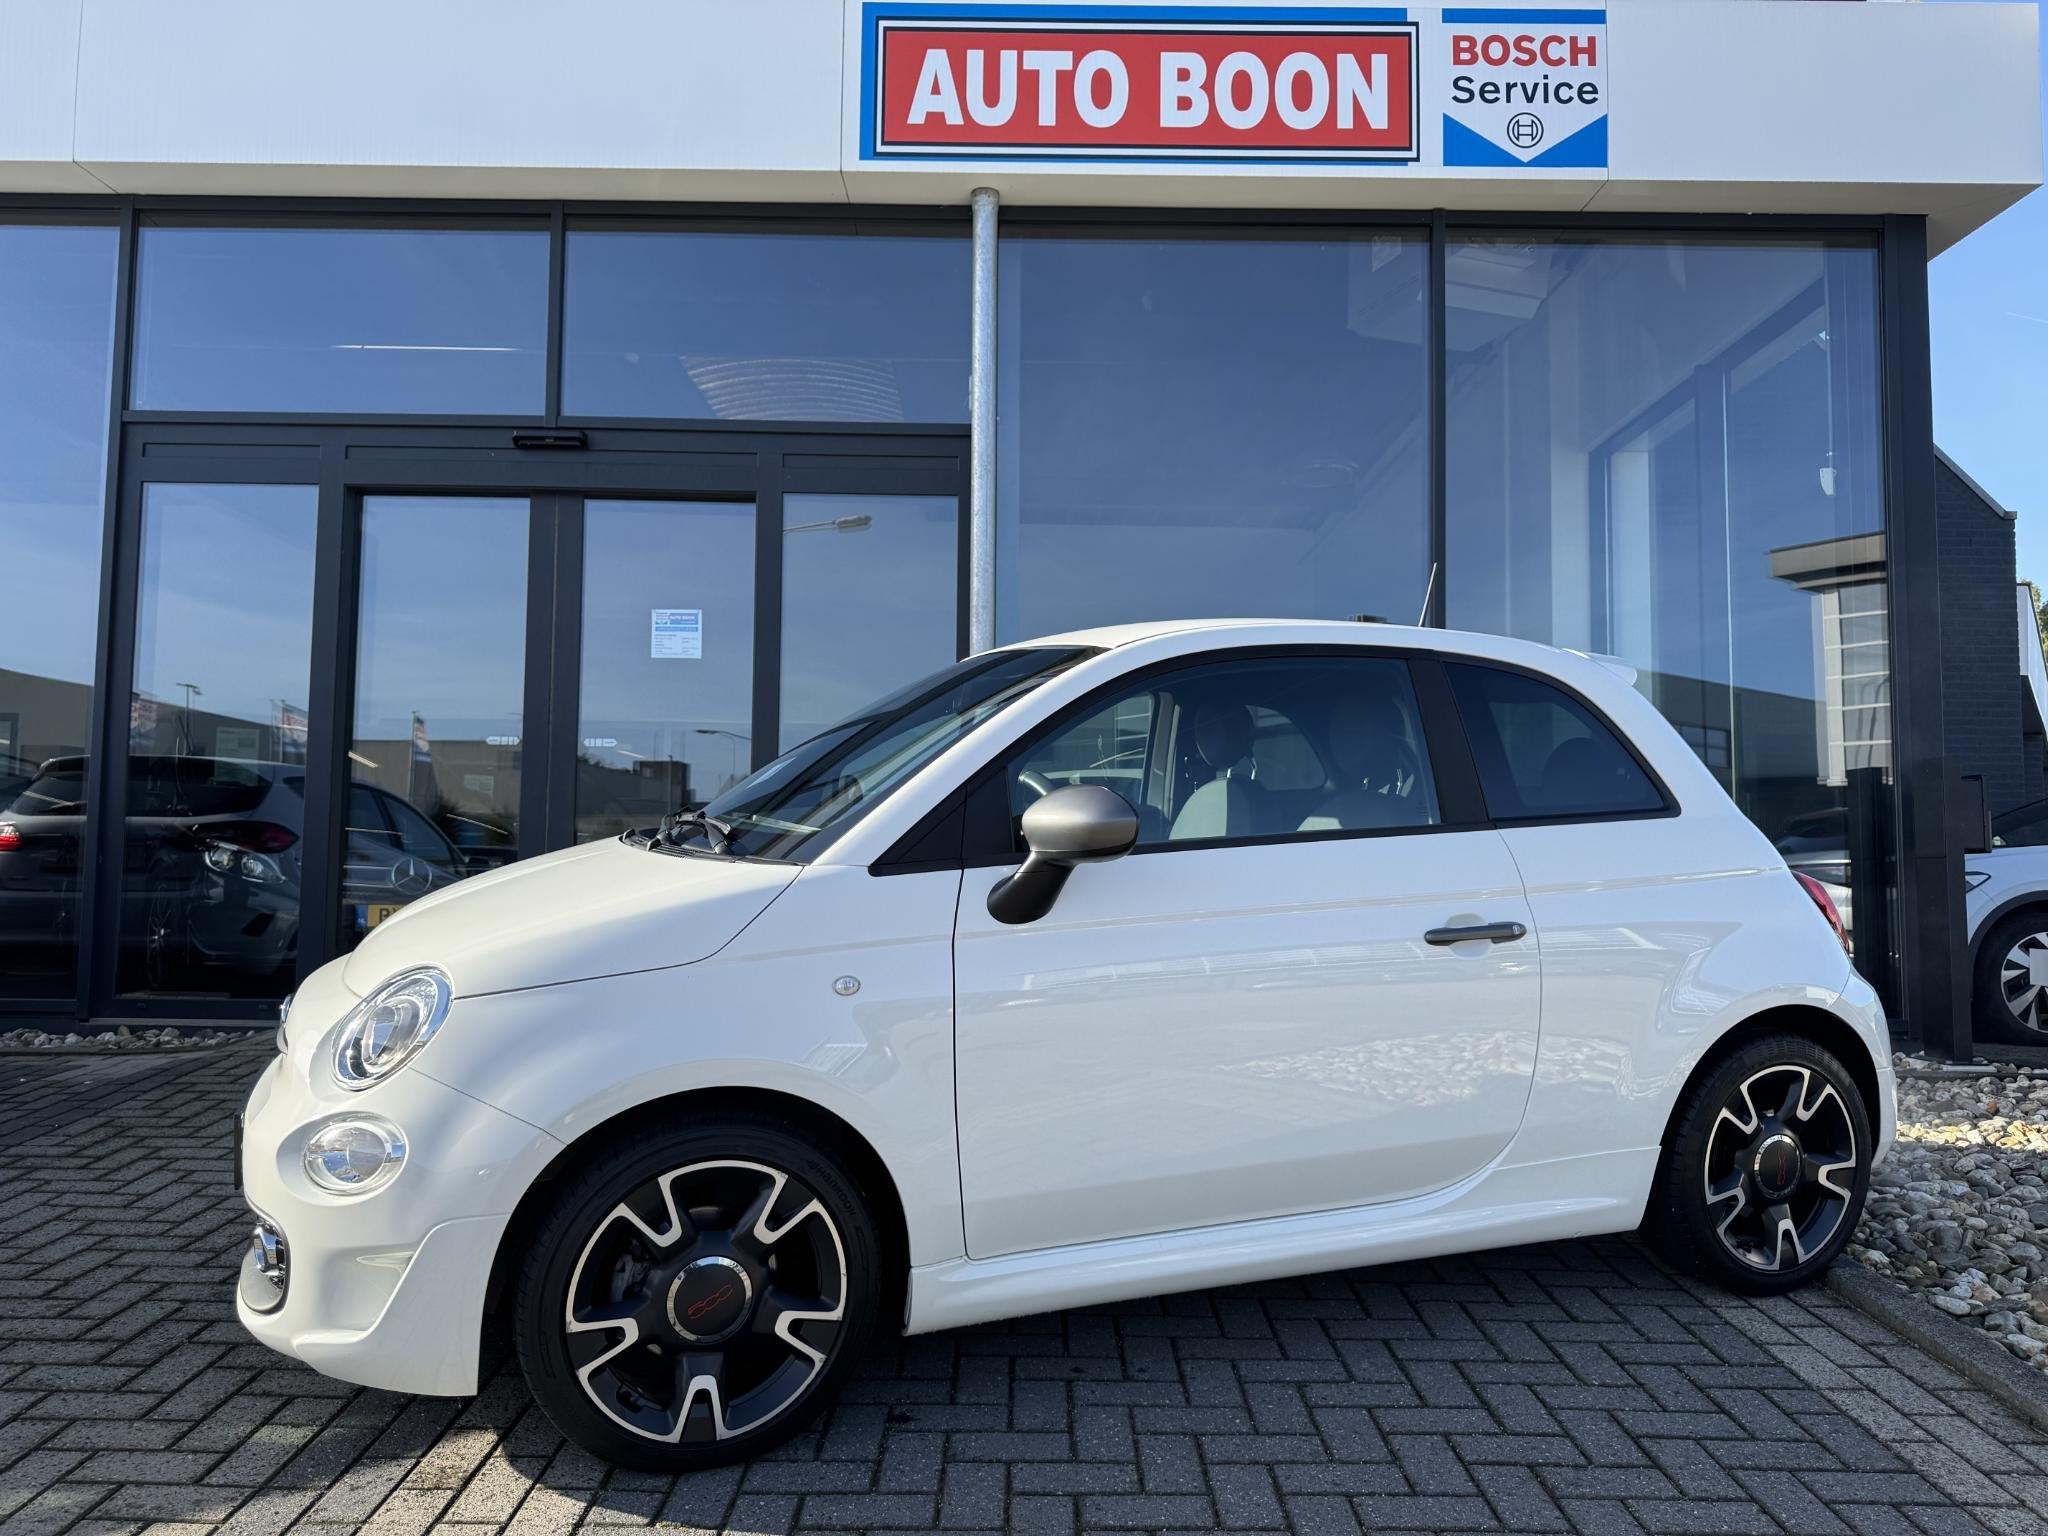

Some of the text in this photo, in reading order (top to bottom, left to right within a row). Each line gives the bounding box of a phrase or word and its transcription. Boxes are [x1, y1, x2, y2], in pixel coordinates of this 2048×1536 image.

[1452, 35, 1597, 66] BOSCH
[906, 49, 1388, 130] AUTO BOON
[1451, 75, 1599, 104] Service
